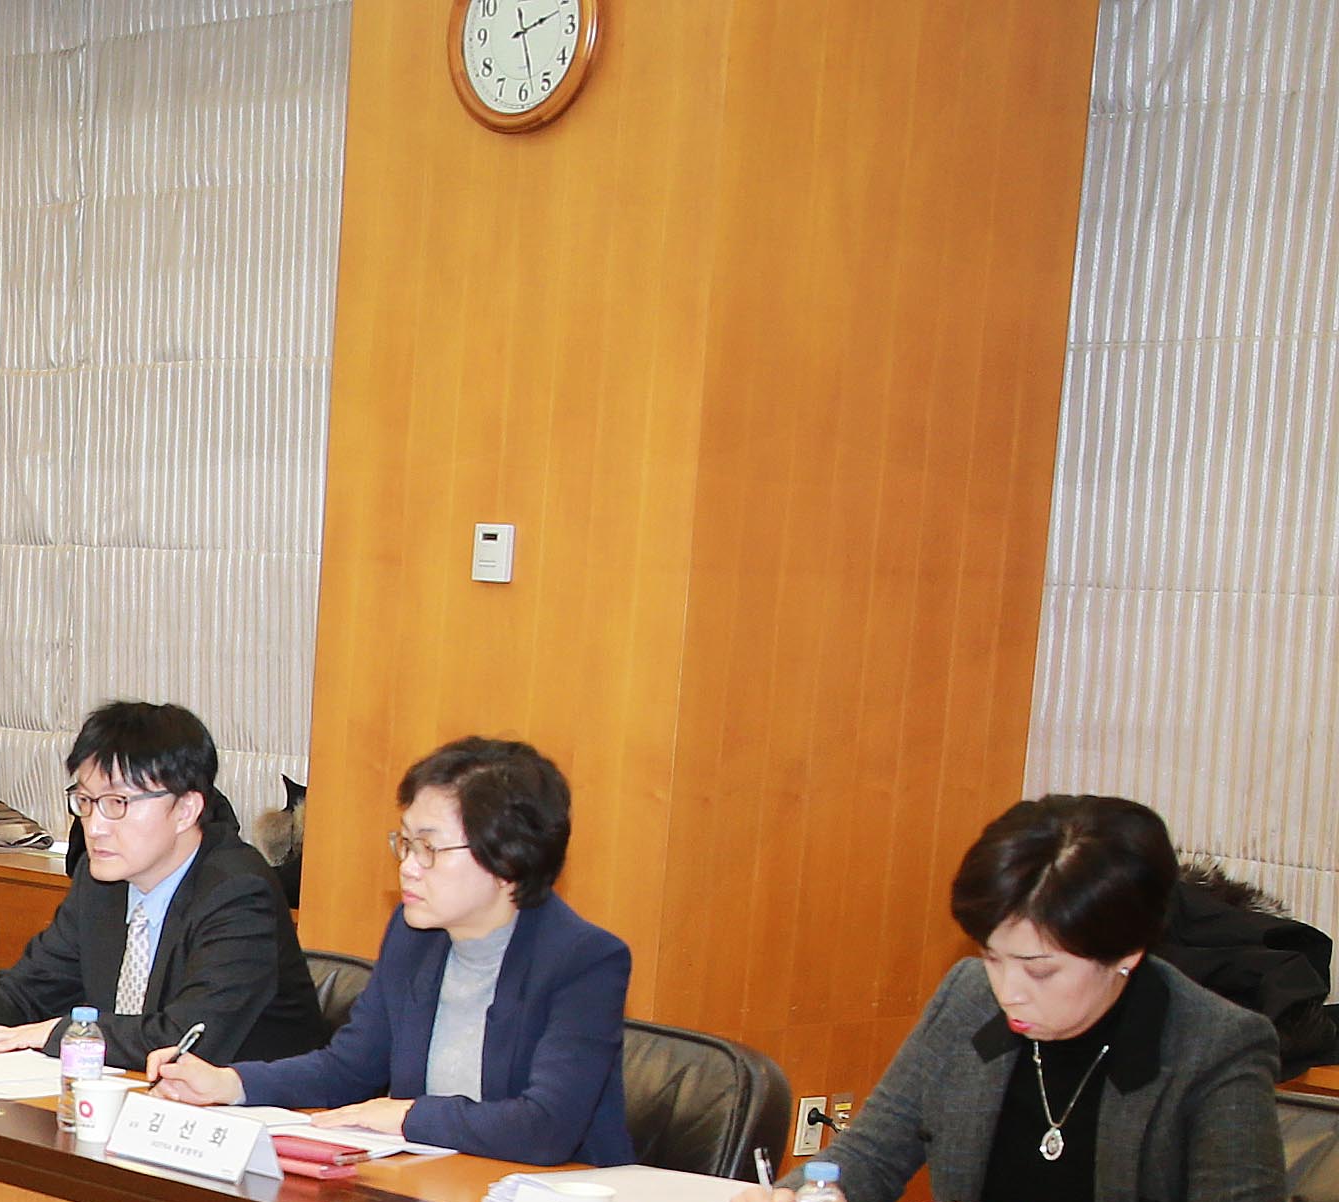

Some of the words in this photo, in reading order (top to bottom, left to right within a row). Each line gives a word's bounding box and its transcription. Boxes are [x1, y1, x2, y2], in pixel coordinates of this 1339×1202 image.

[481, 0, 497, 17] 10
[564, 14, 576, 35] 3
[477, 28, 488, 48] 9
[556, 46, 568, 66] 4
[481, 57, 493, 77] 8
[496, 78, 506, 98] 7
[541, 71, 552, 92] 5
[518, 82, 529, 102] 6
[149, 1112, 228, 1147] 김선화
